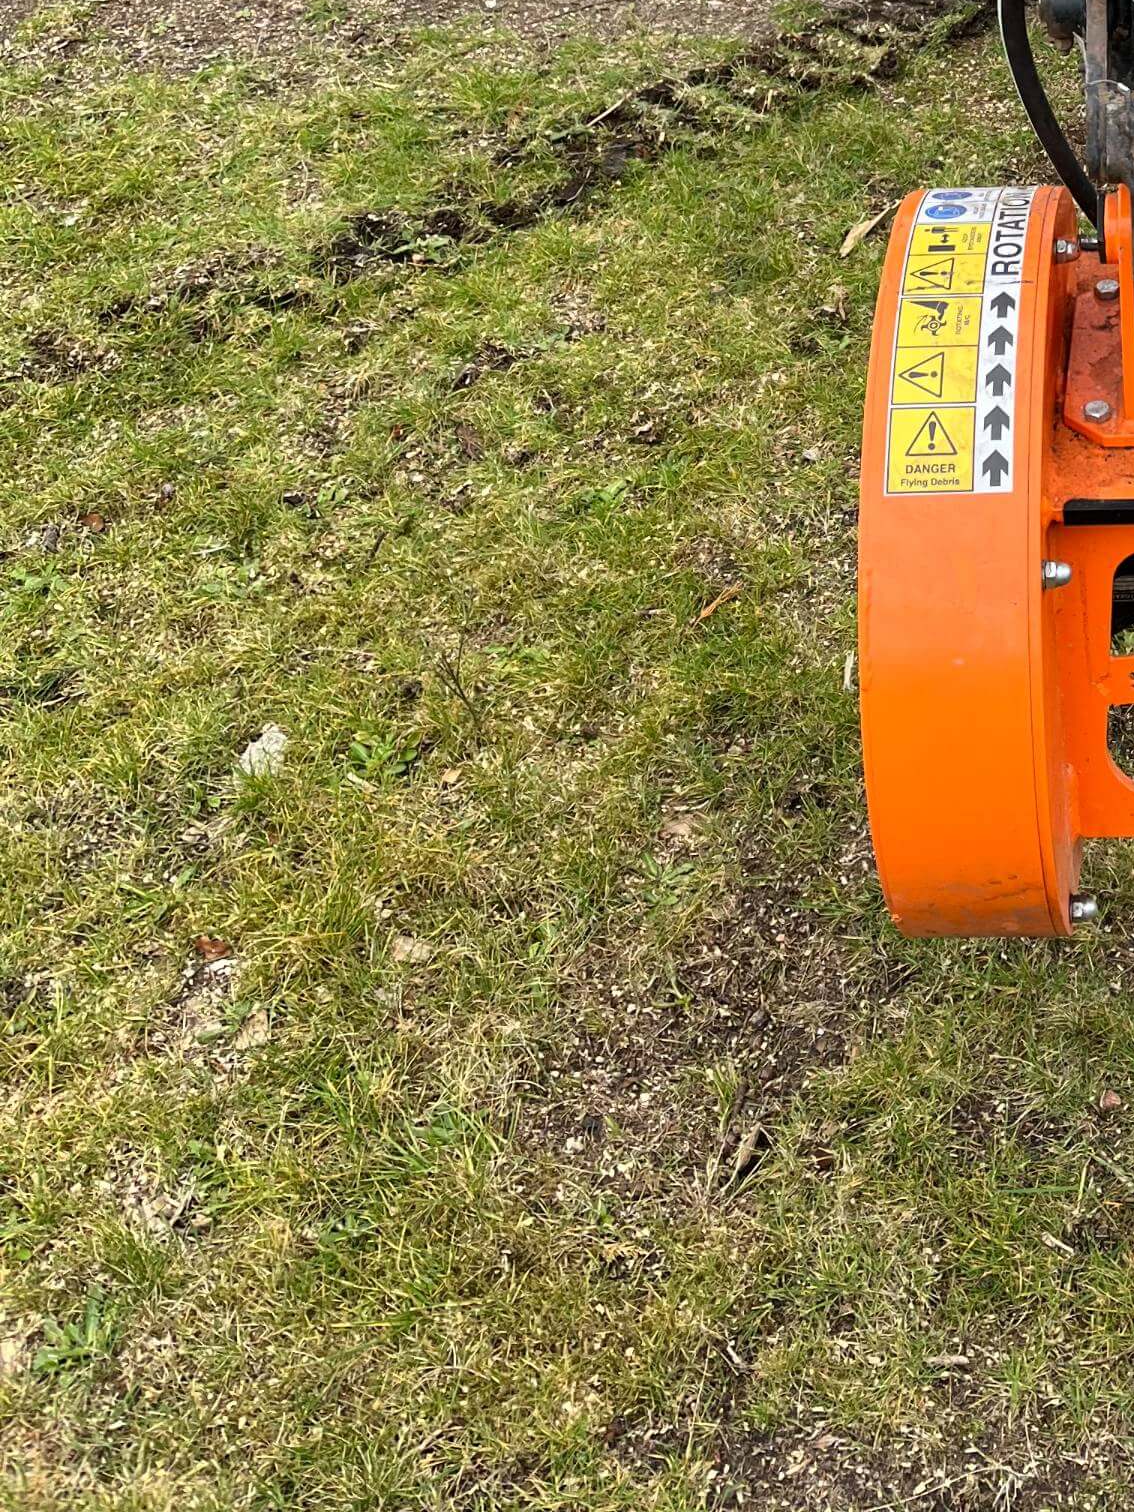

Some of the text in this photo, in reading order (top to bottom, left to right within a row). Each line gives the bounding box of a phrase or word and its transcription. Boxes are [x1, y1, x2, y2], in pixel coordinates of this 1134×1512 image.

[905, 463, 956, 474] DANGER
[900, 478, 960, 488] Flying Debris
